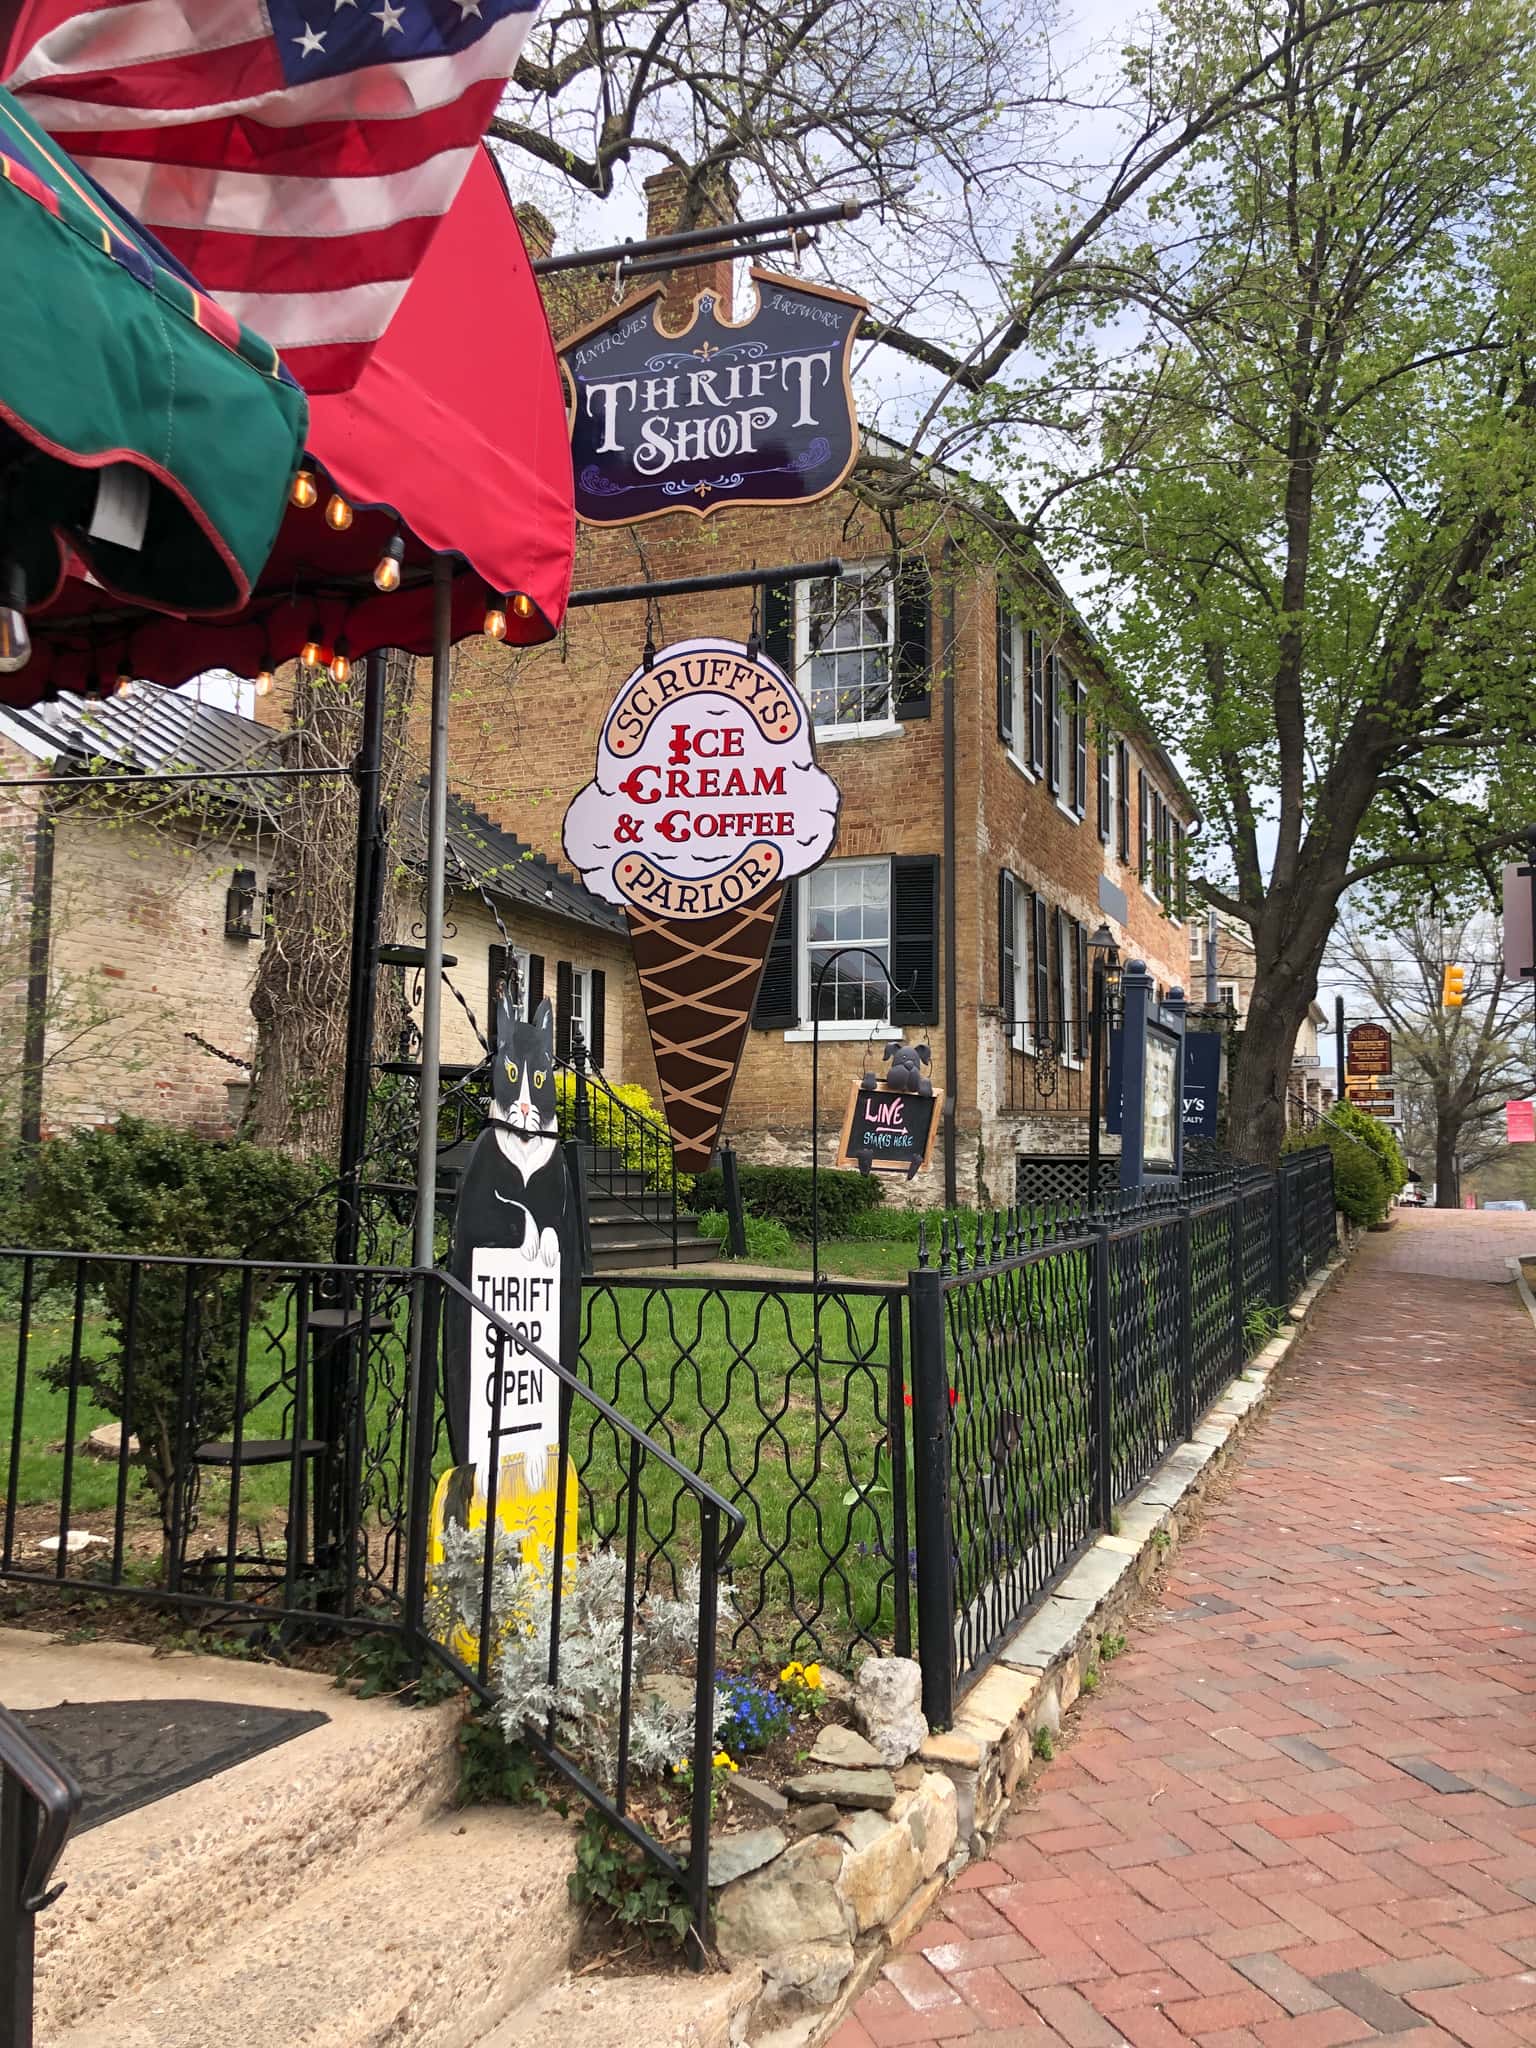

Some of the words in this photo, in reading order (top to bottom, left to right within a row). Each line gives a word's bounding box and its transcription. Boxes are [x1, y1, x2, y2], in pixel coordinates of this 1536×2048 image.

[575, 315, 647, 372] ANTIQUES
[700, 294, 714, 313] &
[763, 294, 842, 329] ARTWORK
[585, 351, 832, 453] THRIFT
[633, 406, 778, 476] SHOP
[617, 658, 791, 740] SCRUFFY'S
[668, 724, 745, 765] ICE
[618, 765, 787, 804] CREAM
[614, 814, 645, 843] &
[654, 810, 795, 842] COFFEE
[625, 858, 771, 914] PARLOR
[864, 1097, 905, 1126] LINE
[1182, 1116, 1204, 1124] EALTY
[863, 1132, 891, 1149] STARTS
[893, 1134, 913, 1147] HERE
[477, 1275, 554, 1312] THRIFT
